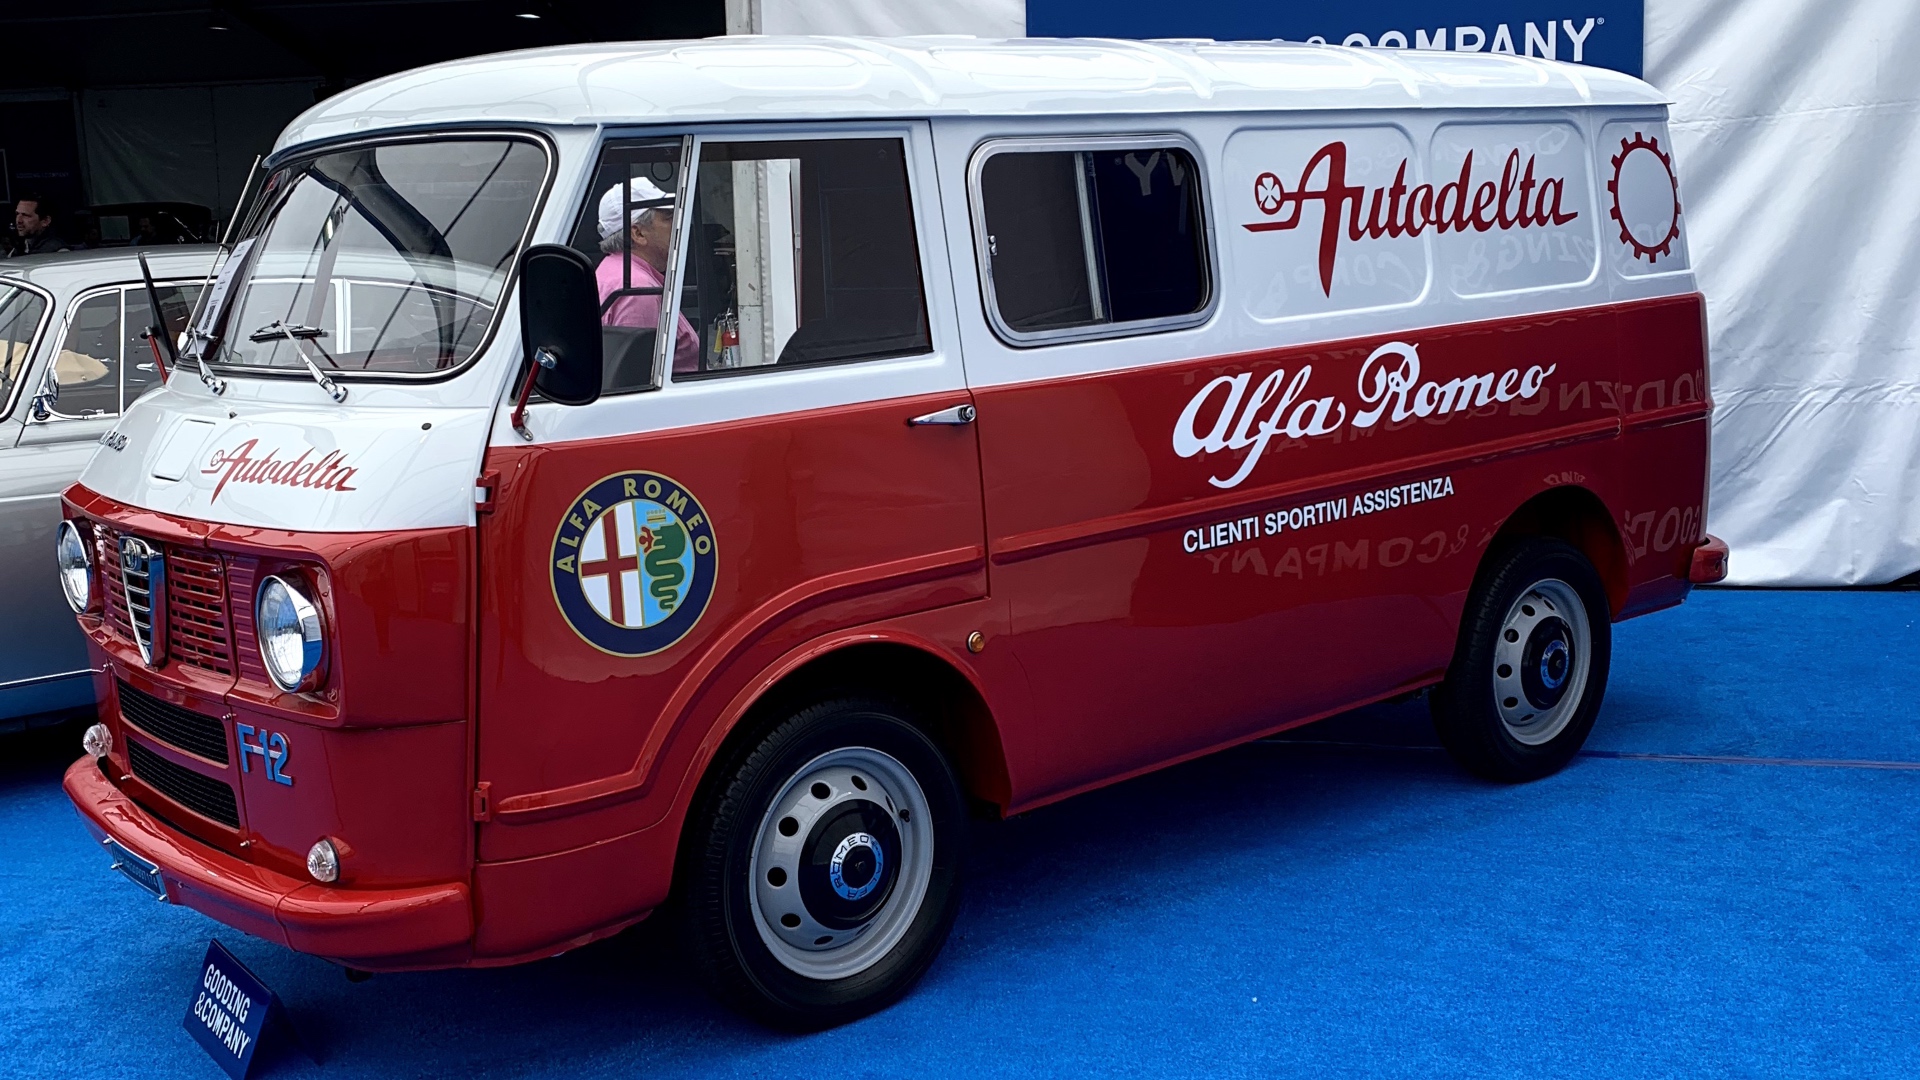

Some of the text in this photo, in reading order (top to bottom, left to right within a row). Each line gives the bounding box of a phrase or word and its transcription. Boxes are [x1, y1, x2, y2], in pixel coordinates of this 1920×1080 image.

[1241, 141, 1579, 299] Autodelta
[1172, 364, 1347, 489] Alfa
[1351, 341, 1557, 429] Romeo
[200, 438, 360, 506] Autodelta
[556, 478, 711, 573] ALFA ROMEO
[1182, 482, 1456, 553] CLIENTI SPORTIVI ASSISTENZA
[203, 963, 251, 1025] GOODING
